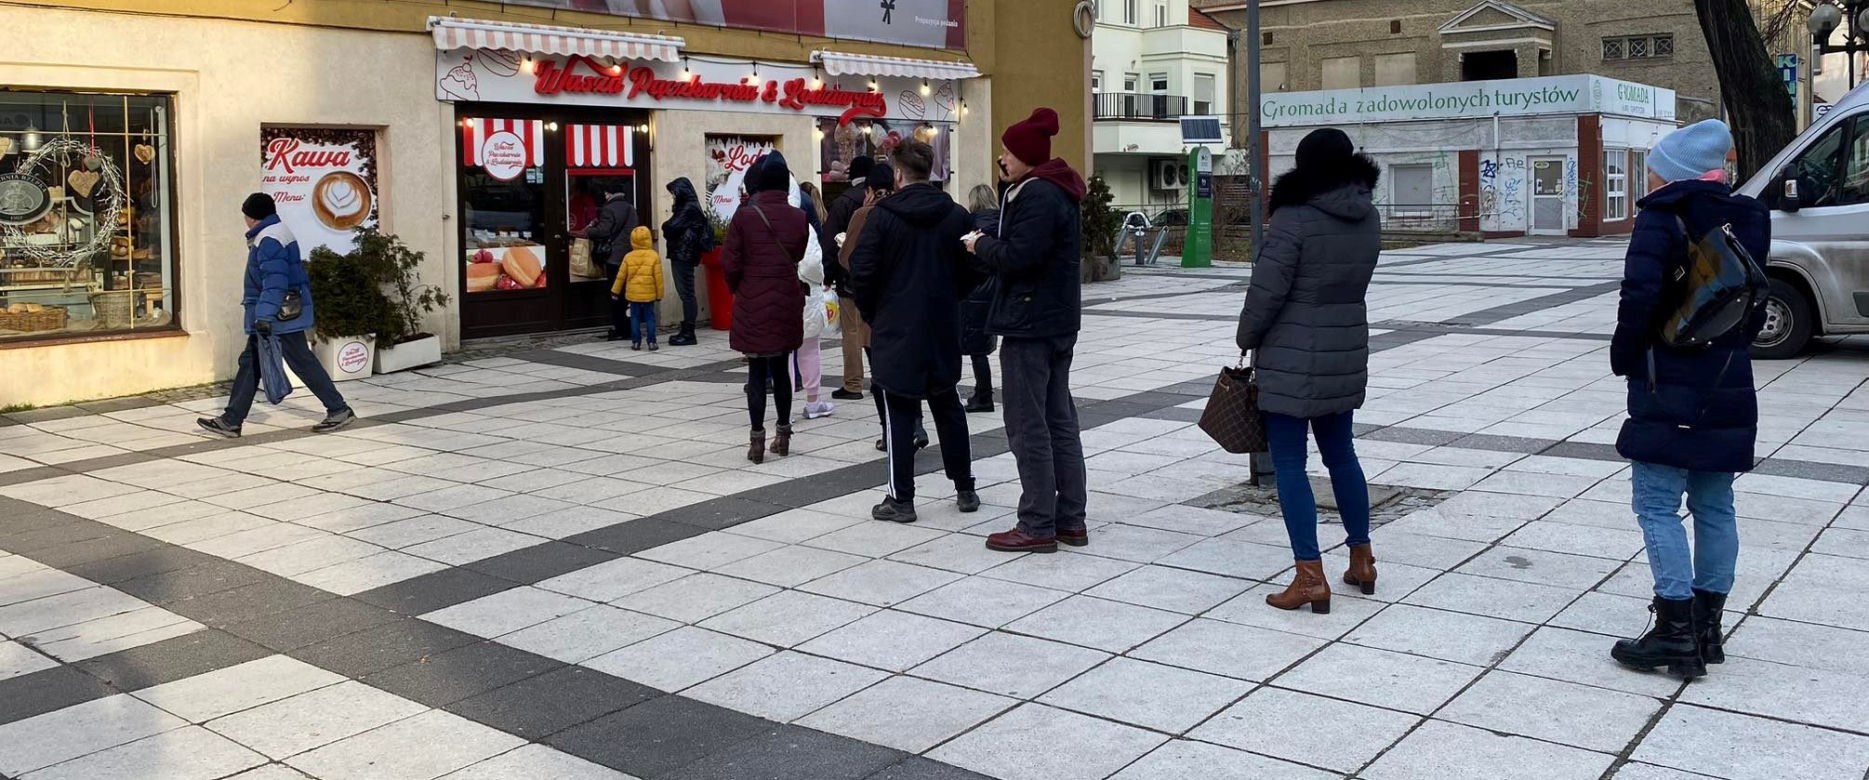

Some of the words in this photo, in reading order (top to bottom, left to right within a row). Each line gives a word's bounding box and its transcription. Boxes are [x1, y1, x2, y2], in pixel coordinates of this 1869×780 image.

[534, 54, 628, 95] Wasza
[761, 80, 778, 102] &
[1262, 97, 1347, 120] Gromada
[1356, 88, 1490, 113] zadowolonych
[1494, 85, 1580, 110] turystów
[267, 137, 350, 174] Kawa
[724, 145, 763, 171] Lod
[262, 175, 276, 183] na
[278, 175, 310, 184] wynos
